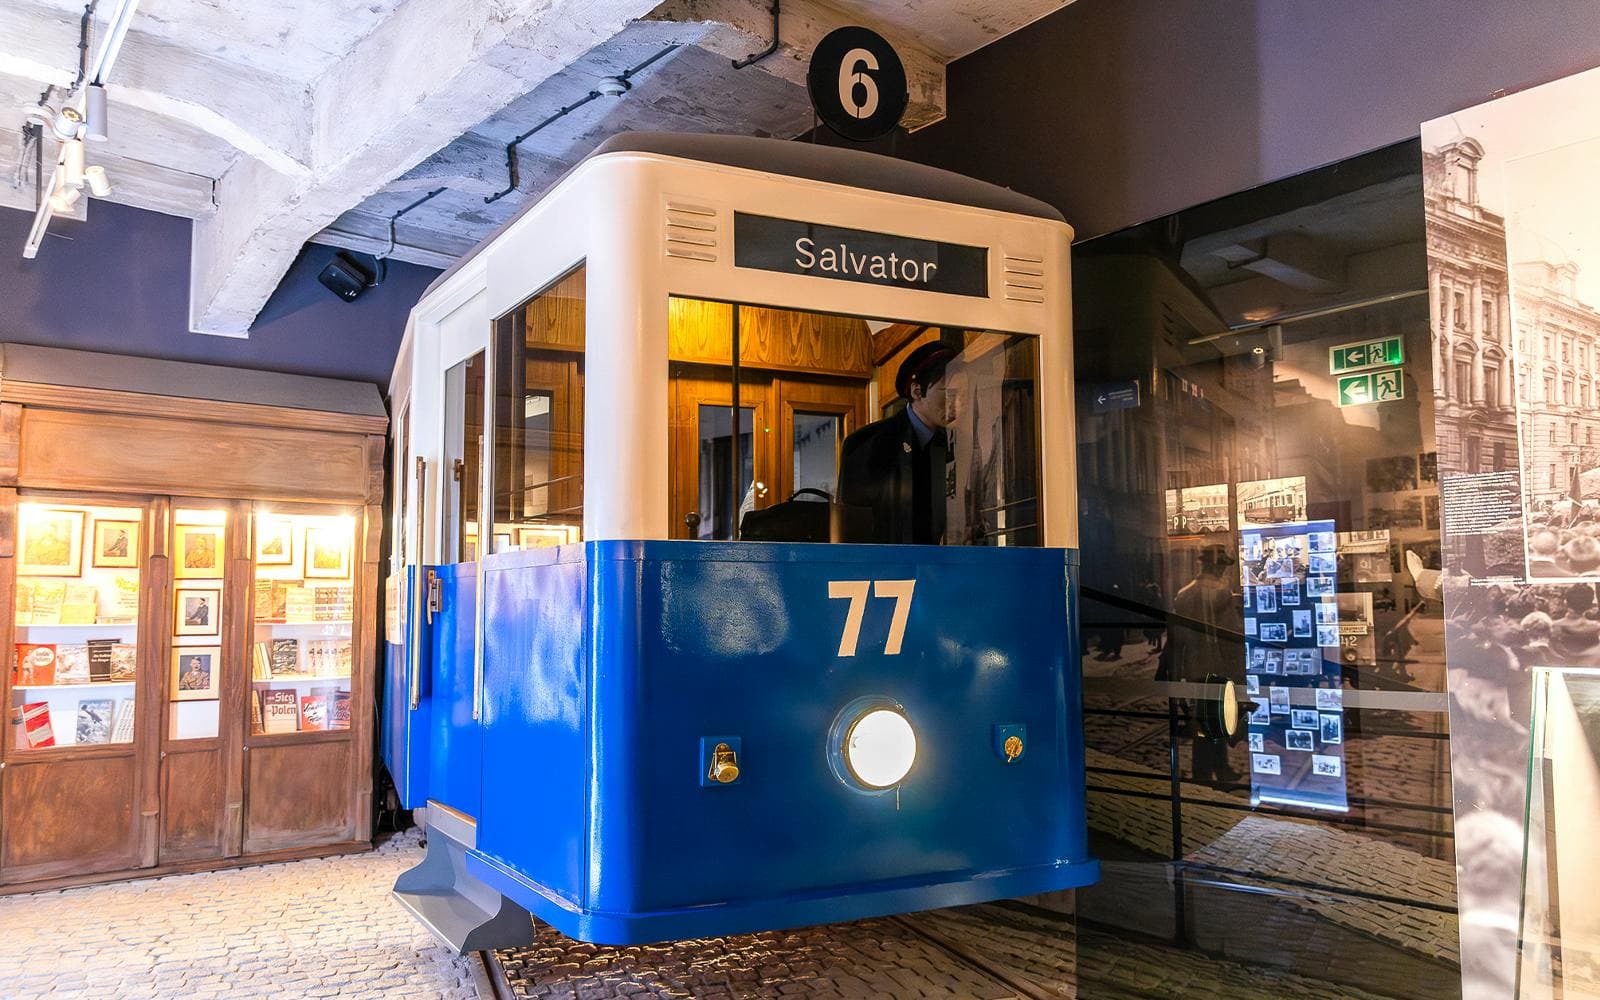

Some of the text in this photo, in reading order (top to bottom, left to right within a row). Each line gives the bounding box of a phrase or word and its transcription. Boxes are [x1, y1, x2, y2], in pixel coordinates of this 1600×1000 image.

[839, 48, 879, 118] 6
[795, 237, 937, 282] Salvator
[828, 579, 916, 657] 77
[271, 705, 296, 717] Polen
[274, 692, 295, 703] Sieg
